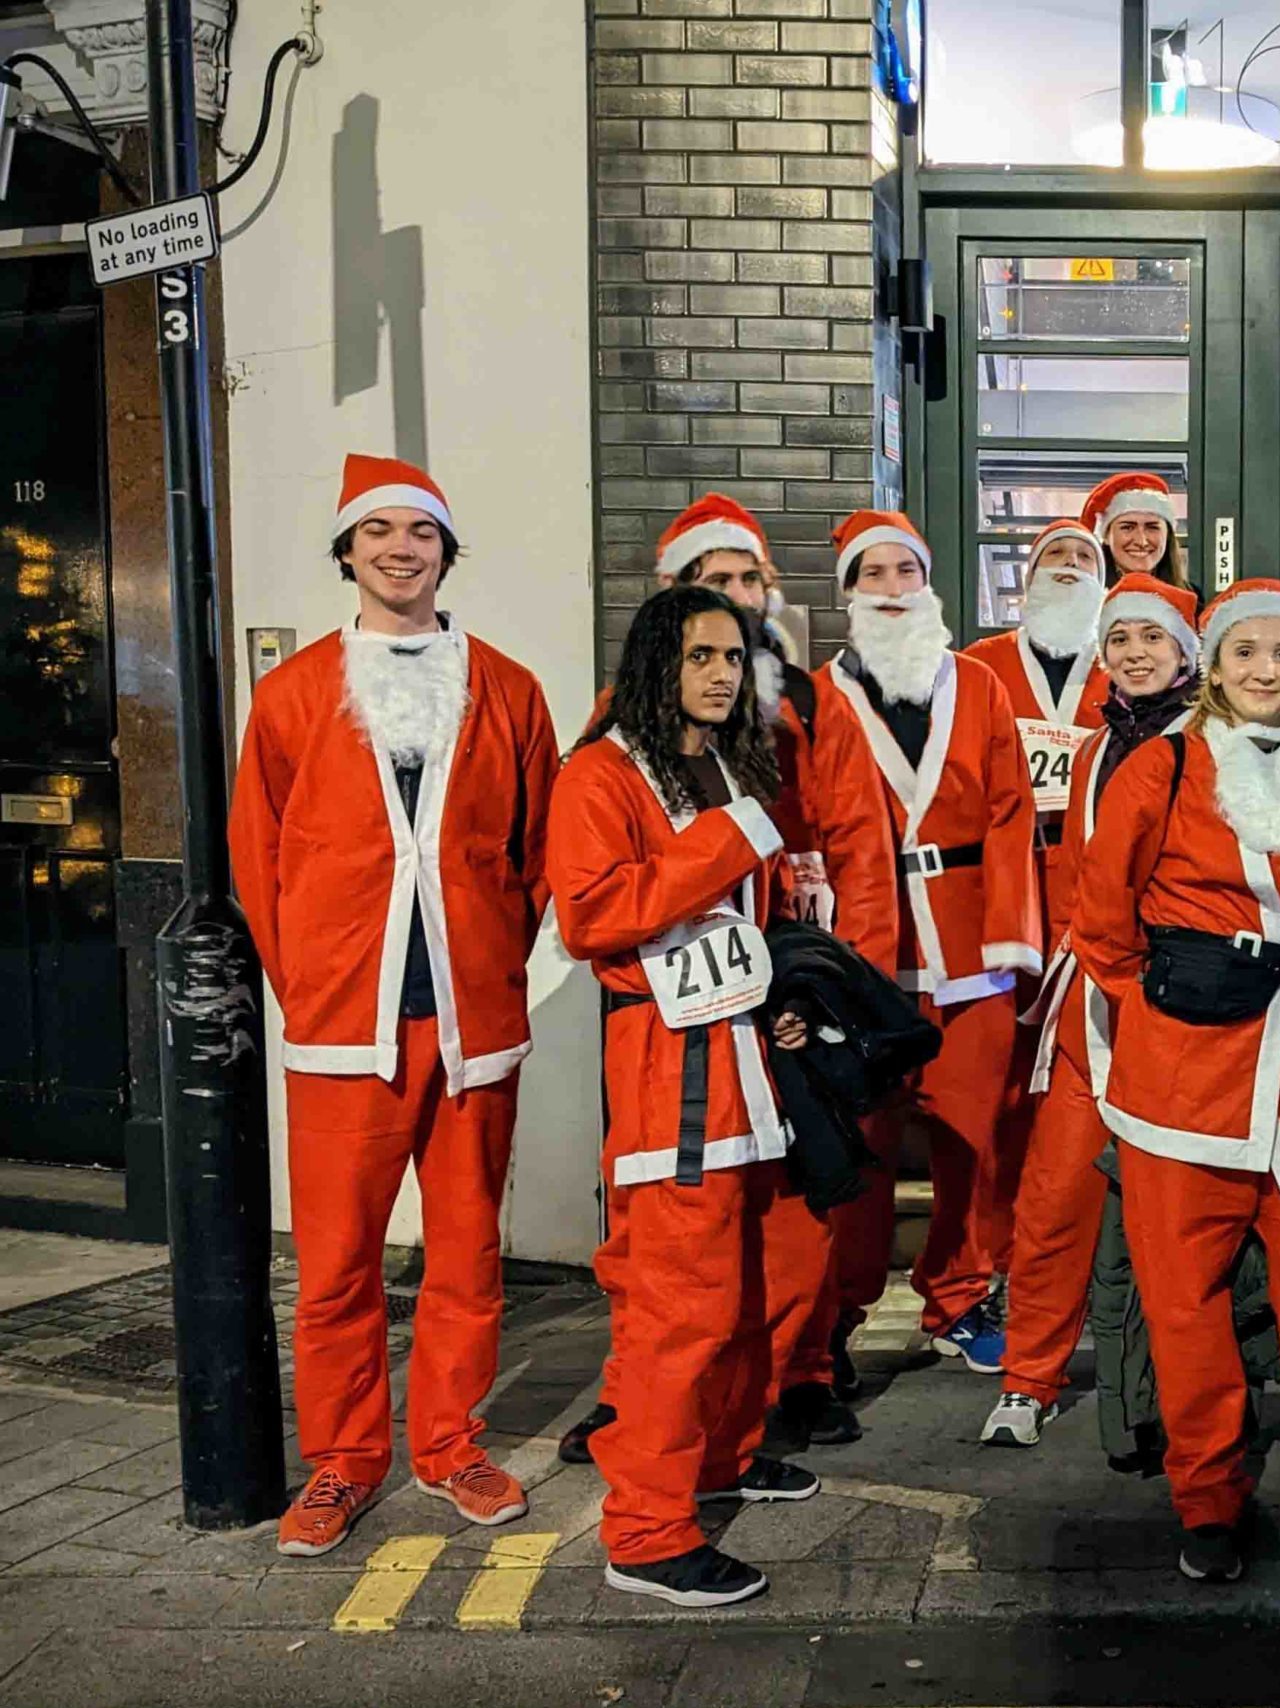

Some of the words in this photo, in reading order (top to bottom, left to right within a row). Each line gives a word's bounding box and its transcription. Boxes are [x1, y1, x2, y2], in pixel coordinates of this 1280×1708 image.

[98, 229, 125, 248] No
[131, 211, 199, 240] loading
[100, 252, 119, 272] at
[125, 246, 157, 266] any
[163, 235, 205, 256] time
[14, 480, 45, 502] 118
[1219, 525, 1229, 583] PUSH
[1027, 726, 1071, 739] Santa
[1030, 750, 1070, 788] 24
[664, 926, 752, 999] 214
